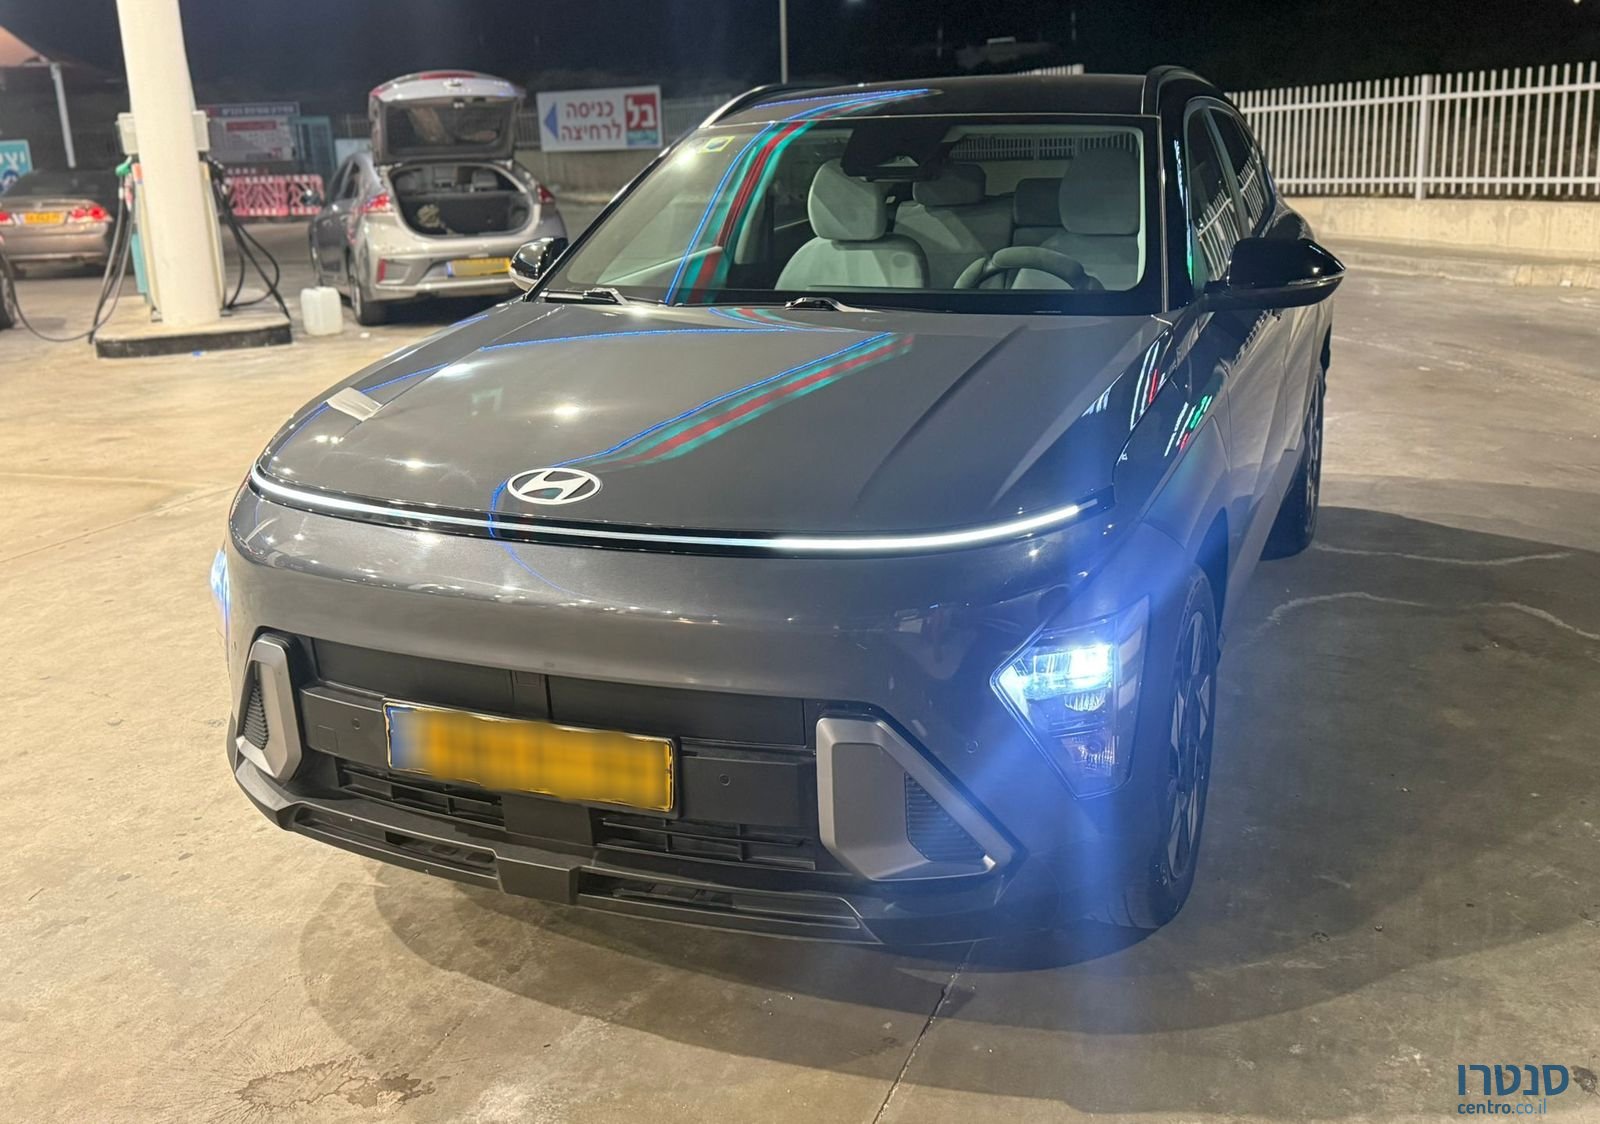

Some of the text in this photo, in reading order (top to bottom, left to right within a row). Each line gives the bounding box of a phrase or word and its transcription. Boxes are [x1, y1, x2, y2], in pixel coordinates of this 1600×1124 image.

[566, 101, 614, 118] כניסה
[628, 97, 657, 129] בל
[561, 118, 622, 141] לרחיצה
